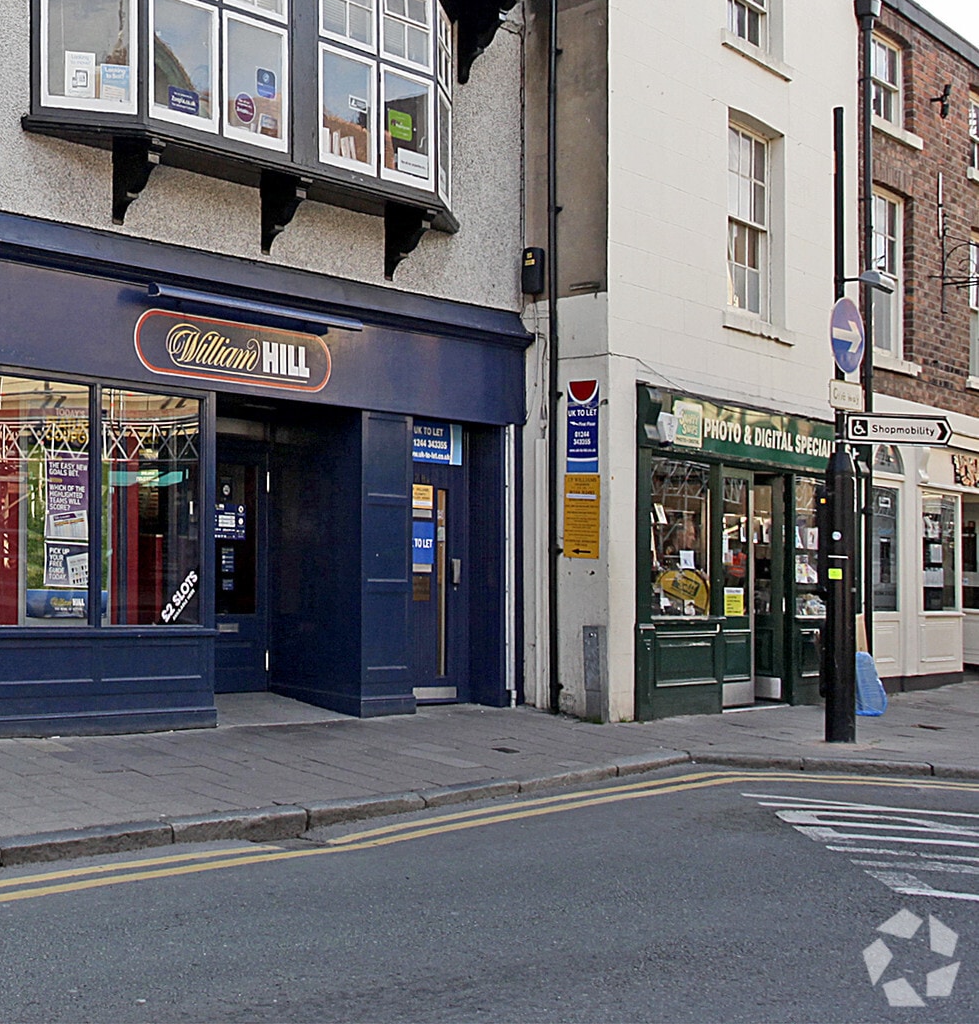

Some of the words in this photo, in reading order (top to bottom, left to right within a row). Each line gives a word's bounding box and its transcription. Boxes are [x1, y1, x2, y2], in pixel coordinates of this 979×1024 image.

[165, 323, 261, 372] William
[262, 341, 310, 378] HILL
[577, 409, 585, 417] TO
[586, 408, 597, 417] LET
[423, 427, 432, 435] TO
[432, 428, 444, 437] LET
[704, 417, 742, 444] PHOTO
[743, 425, 753, 446] &
[754, 427, 794, 453] DIGITAL
[871, 424, 935, 437] Shopmobility
[60, 462, 75, 470] EASY
[49, 468, 67, 476] GOALS
[49, 484, 66, 492] WHICH
[414, 538, 422, 548] TO
[422, 538, 433, 549] LET
[161, 602, 176, 623] £2
[172, 570, 198, 607] SLOTS
[72, 598, 86, 607] HILL
